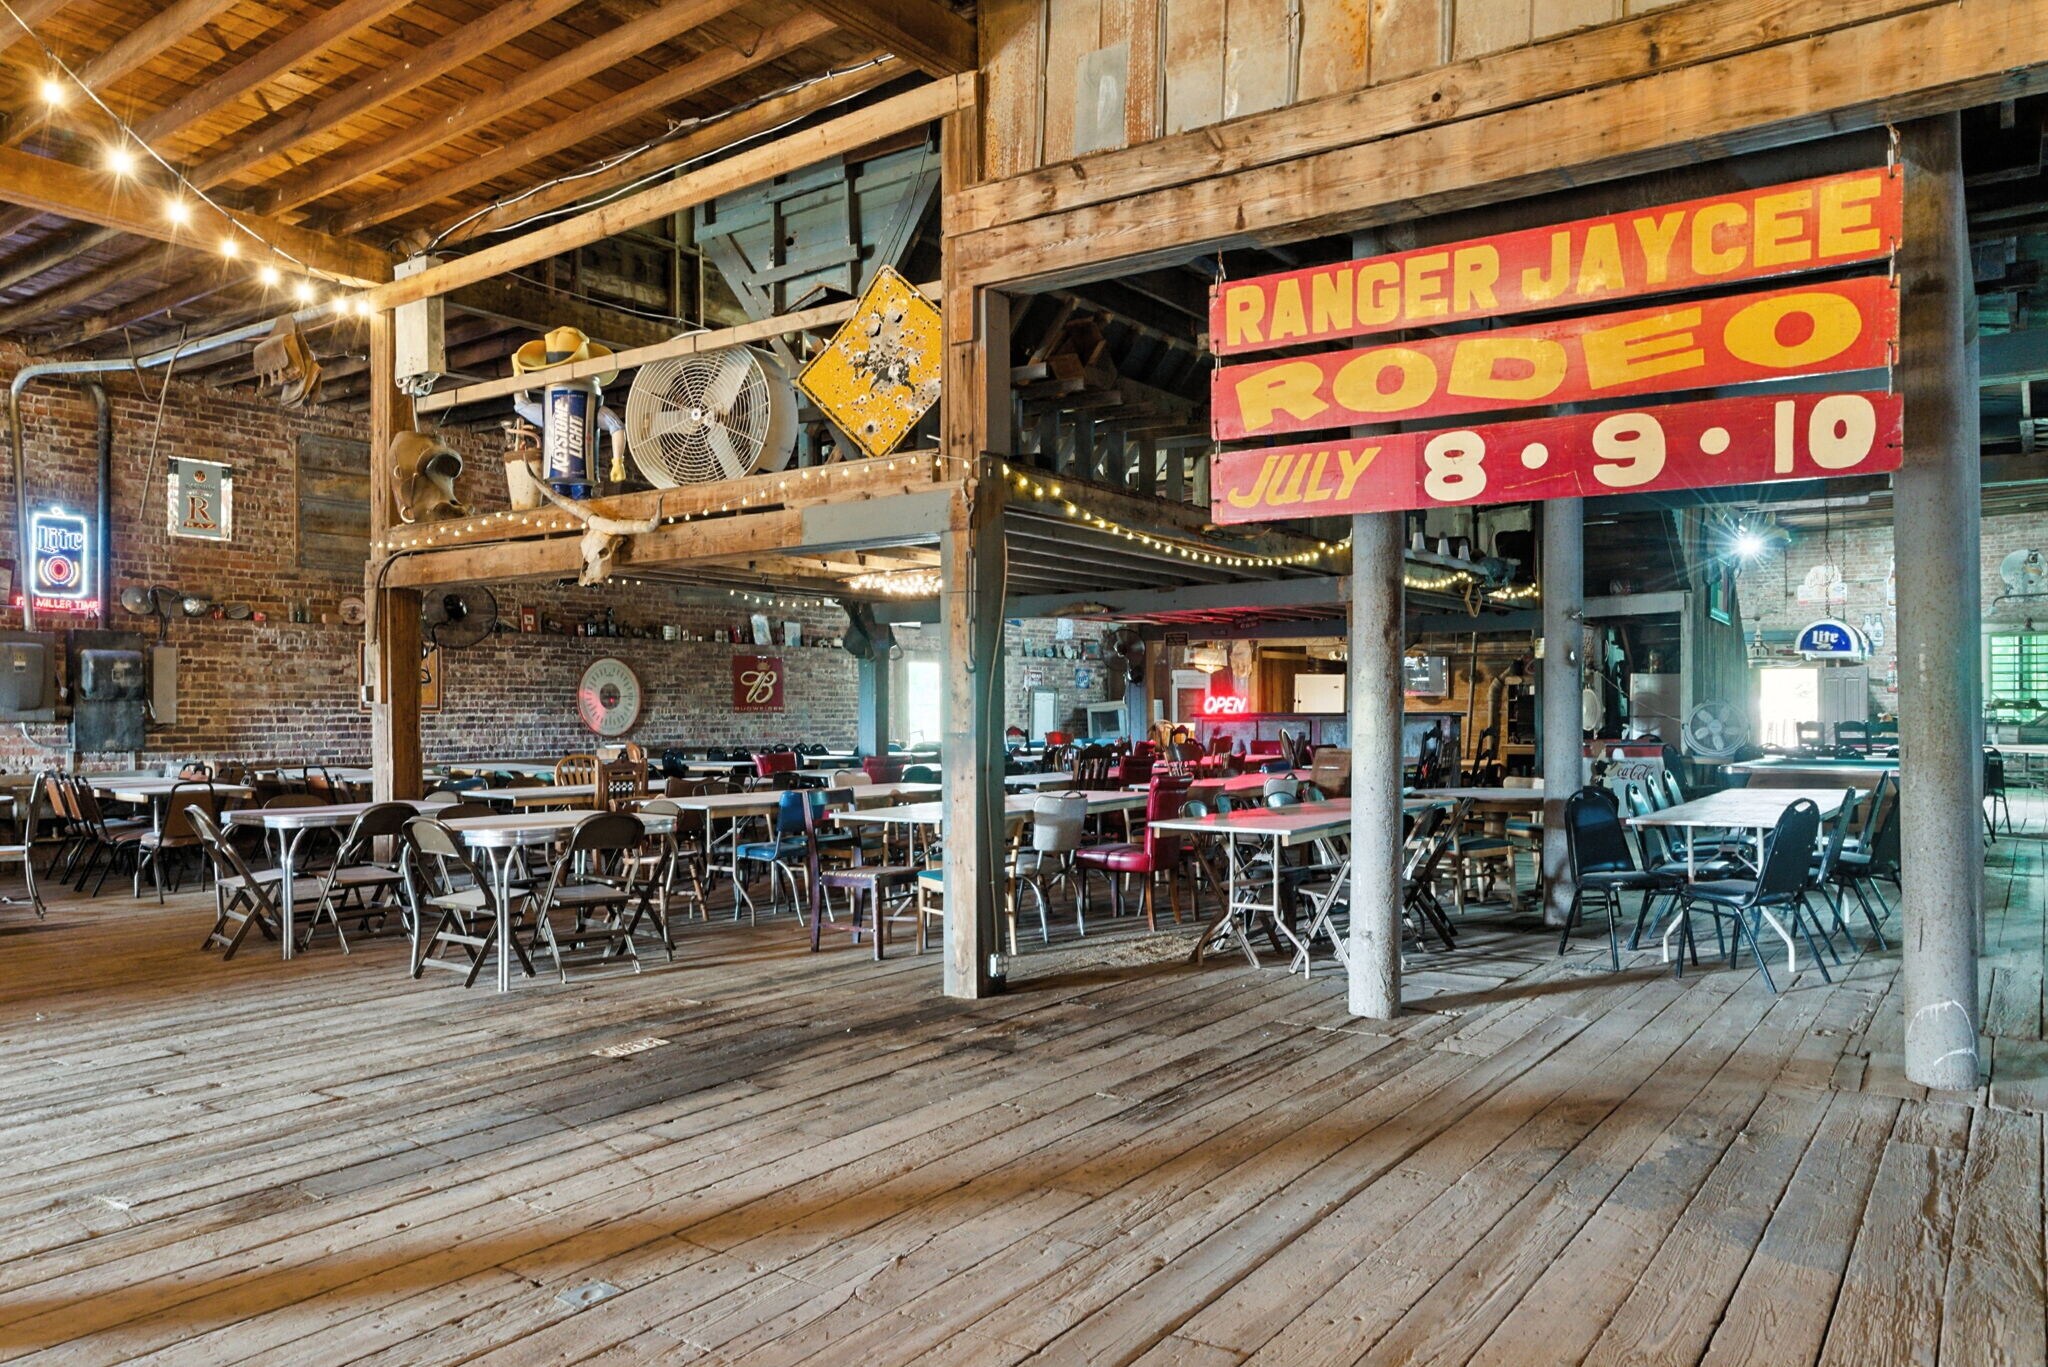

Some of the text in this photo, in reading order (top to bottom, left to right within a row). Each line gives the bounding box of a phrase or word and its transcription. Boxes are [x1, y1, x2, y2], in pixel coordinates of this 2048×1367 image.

[1226, 177, 1881, 346] RANGER JAYCEE
[1235, 292, 1862, 432] RODEO
[552, 398, 569, 473] KEYSTONE
[569, 415, 583, 459] LIGHT
[1227, 394, 1876, 508] JULY 8 9 10
[36, 525, 83, 551] Lite
[37, 598, 72, 609] MILLER
[1812, 630, 1839, 645] Lite
[1203, 697, 1247, 714] OPEN
